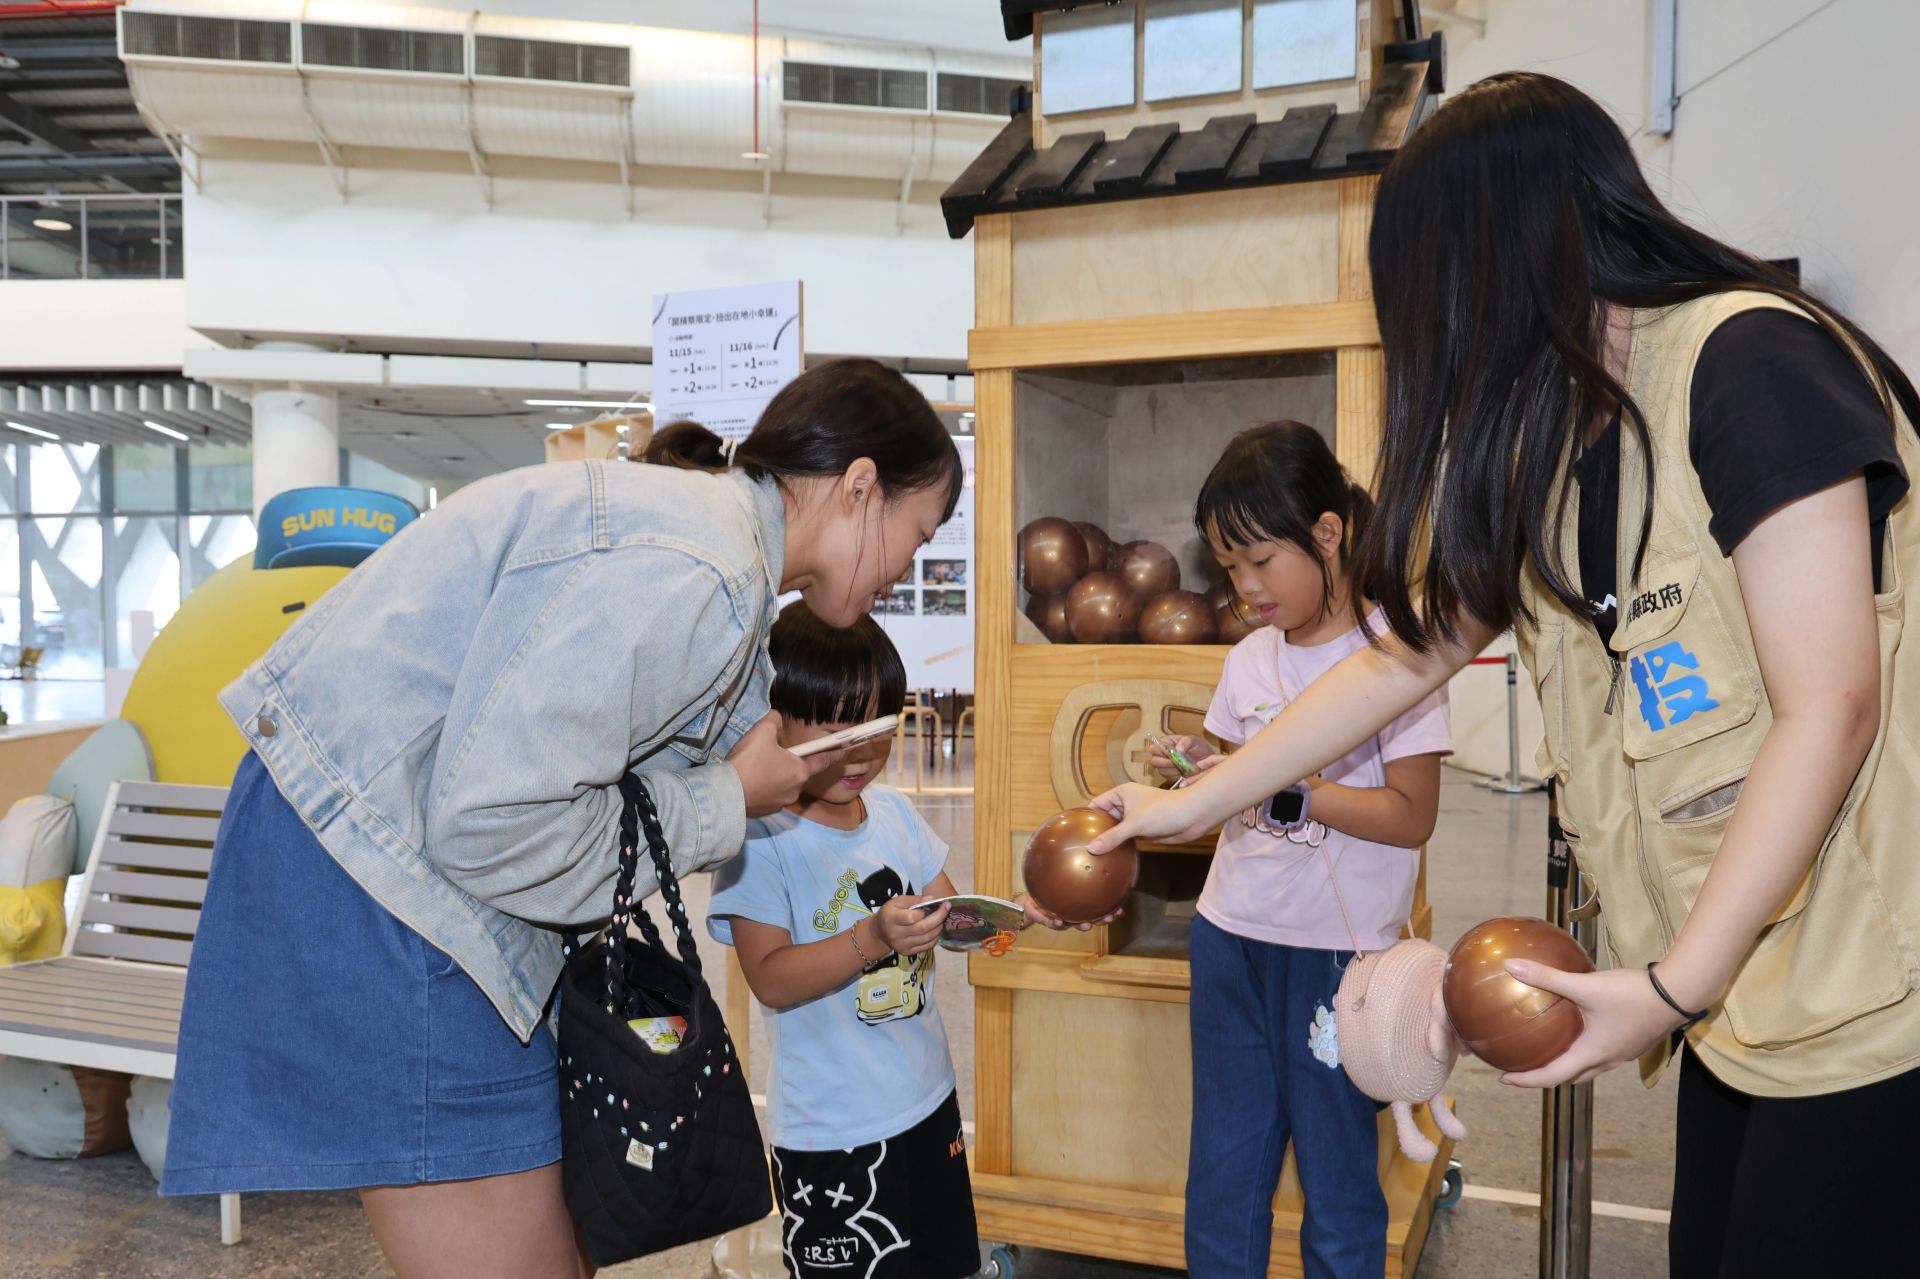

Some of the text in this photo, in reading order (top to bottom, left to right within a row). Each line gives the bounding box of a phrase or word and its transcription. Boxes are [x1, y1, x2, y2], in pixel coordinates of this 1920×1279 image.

[669, 347, 692, 357] 11/15
[729, 341, 753, 352] 11/16
[282, 507, 397, 537] SUN HUG
